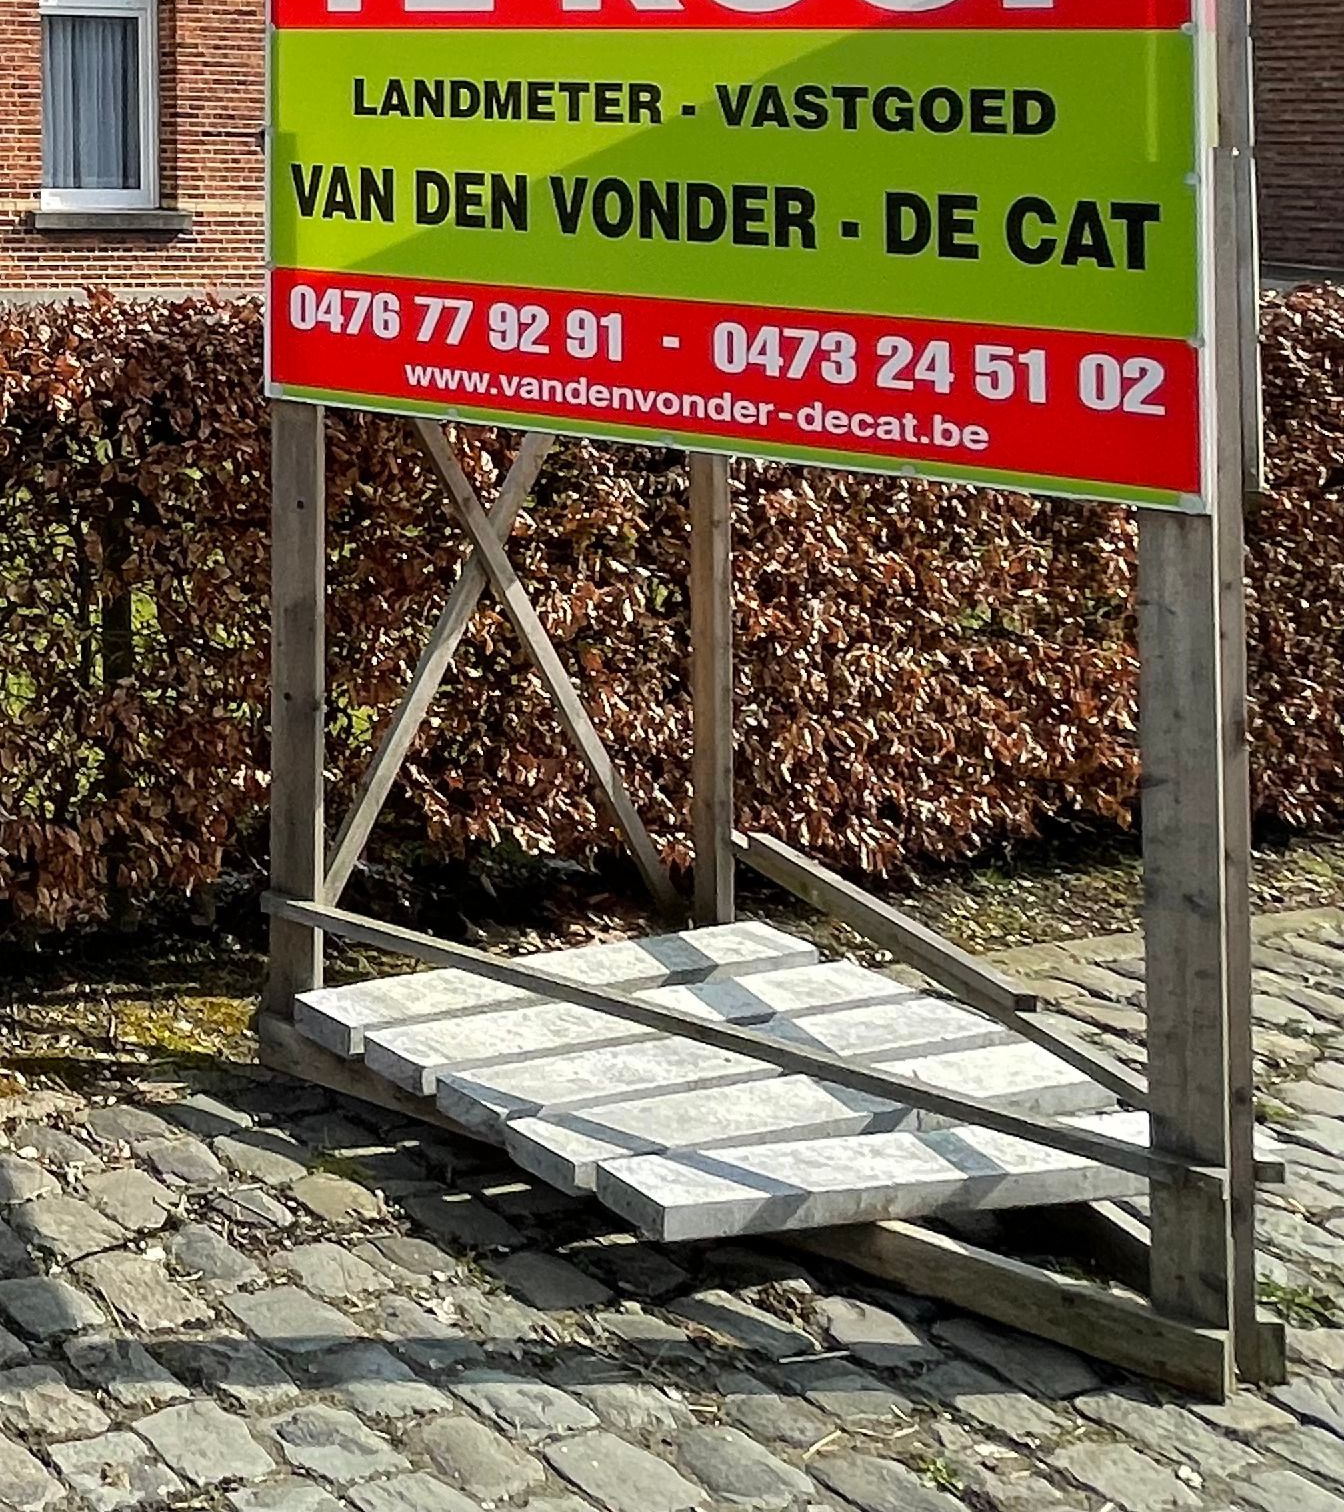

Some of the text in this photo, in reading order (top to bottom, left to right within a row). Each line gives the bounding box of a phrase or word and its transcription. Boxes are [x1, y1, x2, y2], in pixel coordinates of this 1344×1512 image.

[353, 77, 663, 125] LANDMETER
[716, 85, 1057, 137] VASTGOED
[291, 162, 394, 223] VAN
[416, 170, 529, 232] DEN
[550, 176, 817, 249] VONDER
[884, 191, 979, 260] DE
[1006, 197, 1159, 270] CAT
[289, 283, 401, 340] 0476
[414, 295, 471, 345] 77
[488, 302, 550, 354] 92
[566, 309, 624, 362] 91
[714, 321, 855, 385] 0473
[877, 335, 954, 395] 24
[974, 345, 1047, 404] 51
[1079, 353, 1166, 416] 02
[404, 363, 990, 452] www.vandenvonder-decat.be
